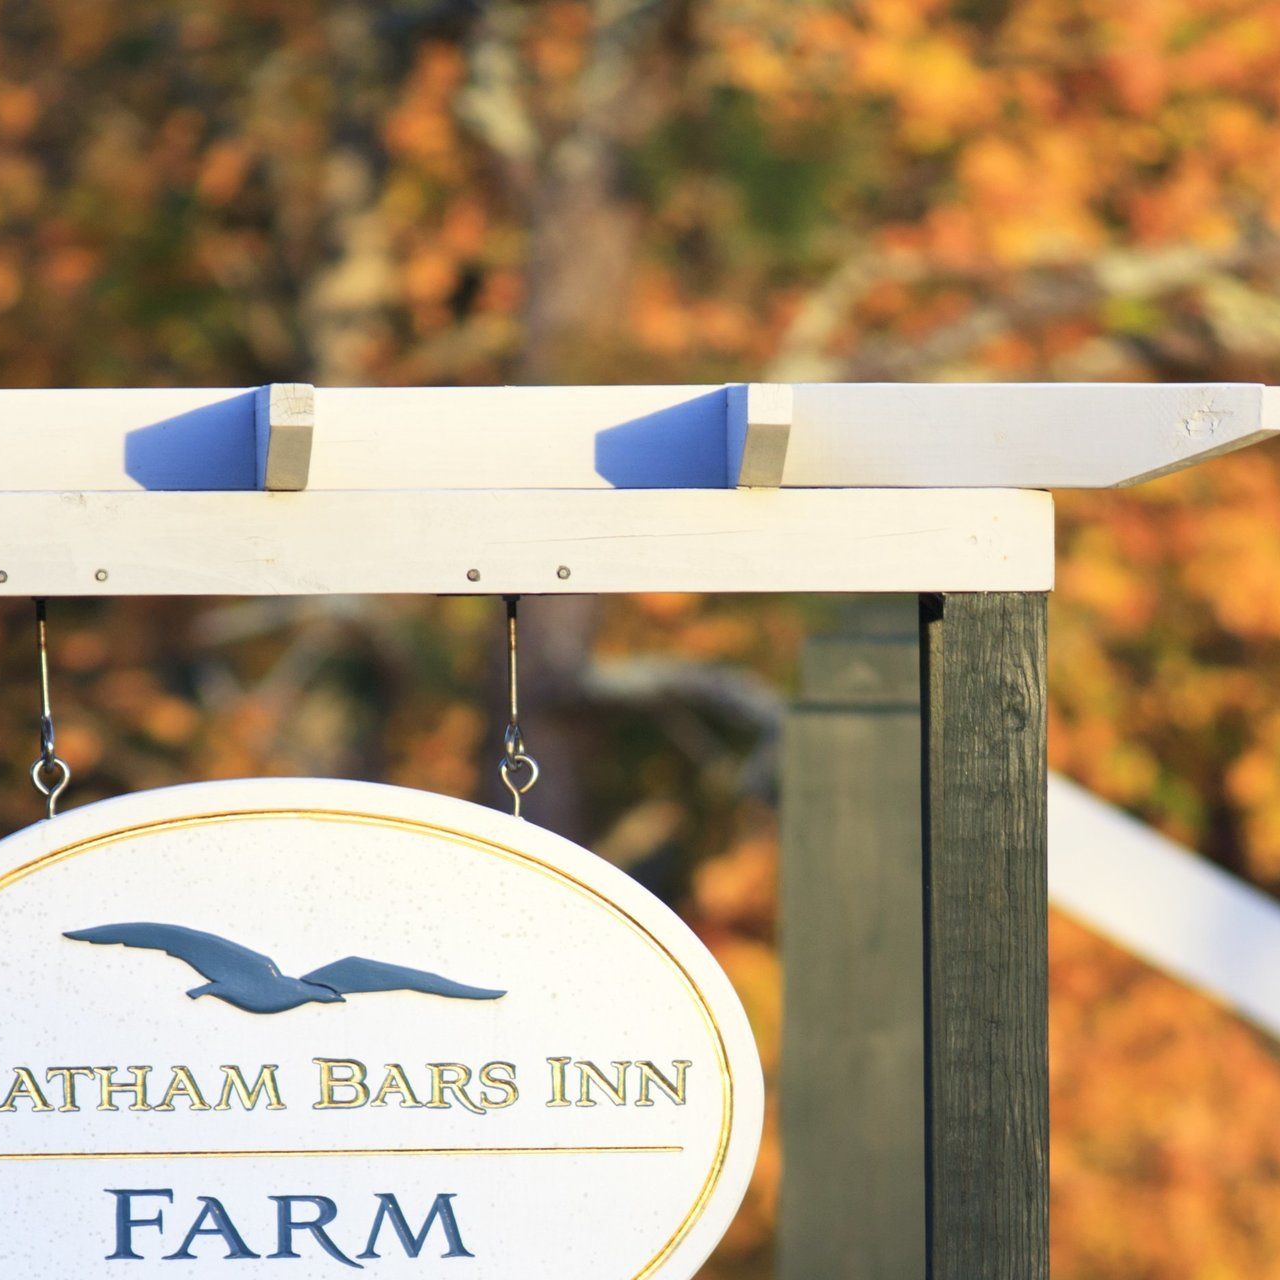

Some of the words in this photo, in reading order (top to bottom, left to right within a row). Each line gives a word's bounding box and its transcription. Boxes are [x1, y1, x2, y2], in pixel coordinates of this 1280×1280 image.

[312, 1057, 518, 1115] BARS
[545, 1056, 692, 1108] INN
[104, 1187, 475, 1268] FARM
